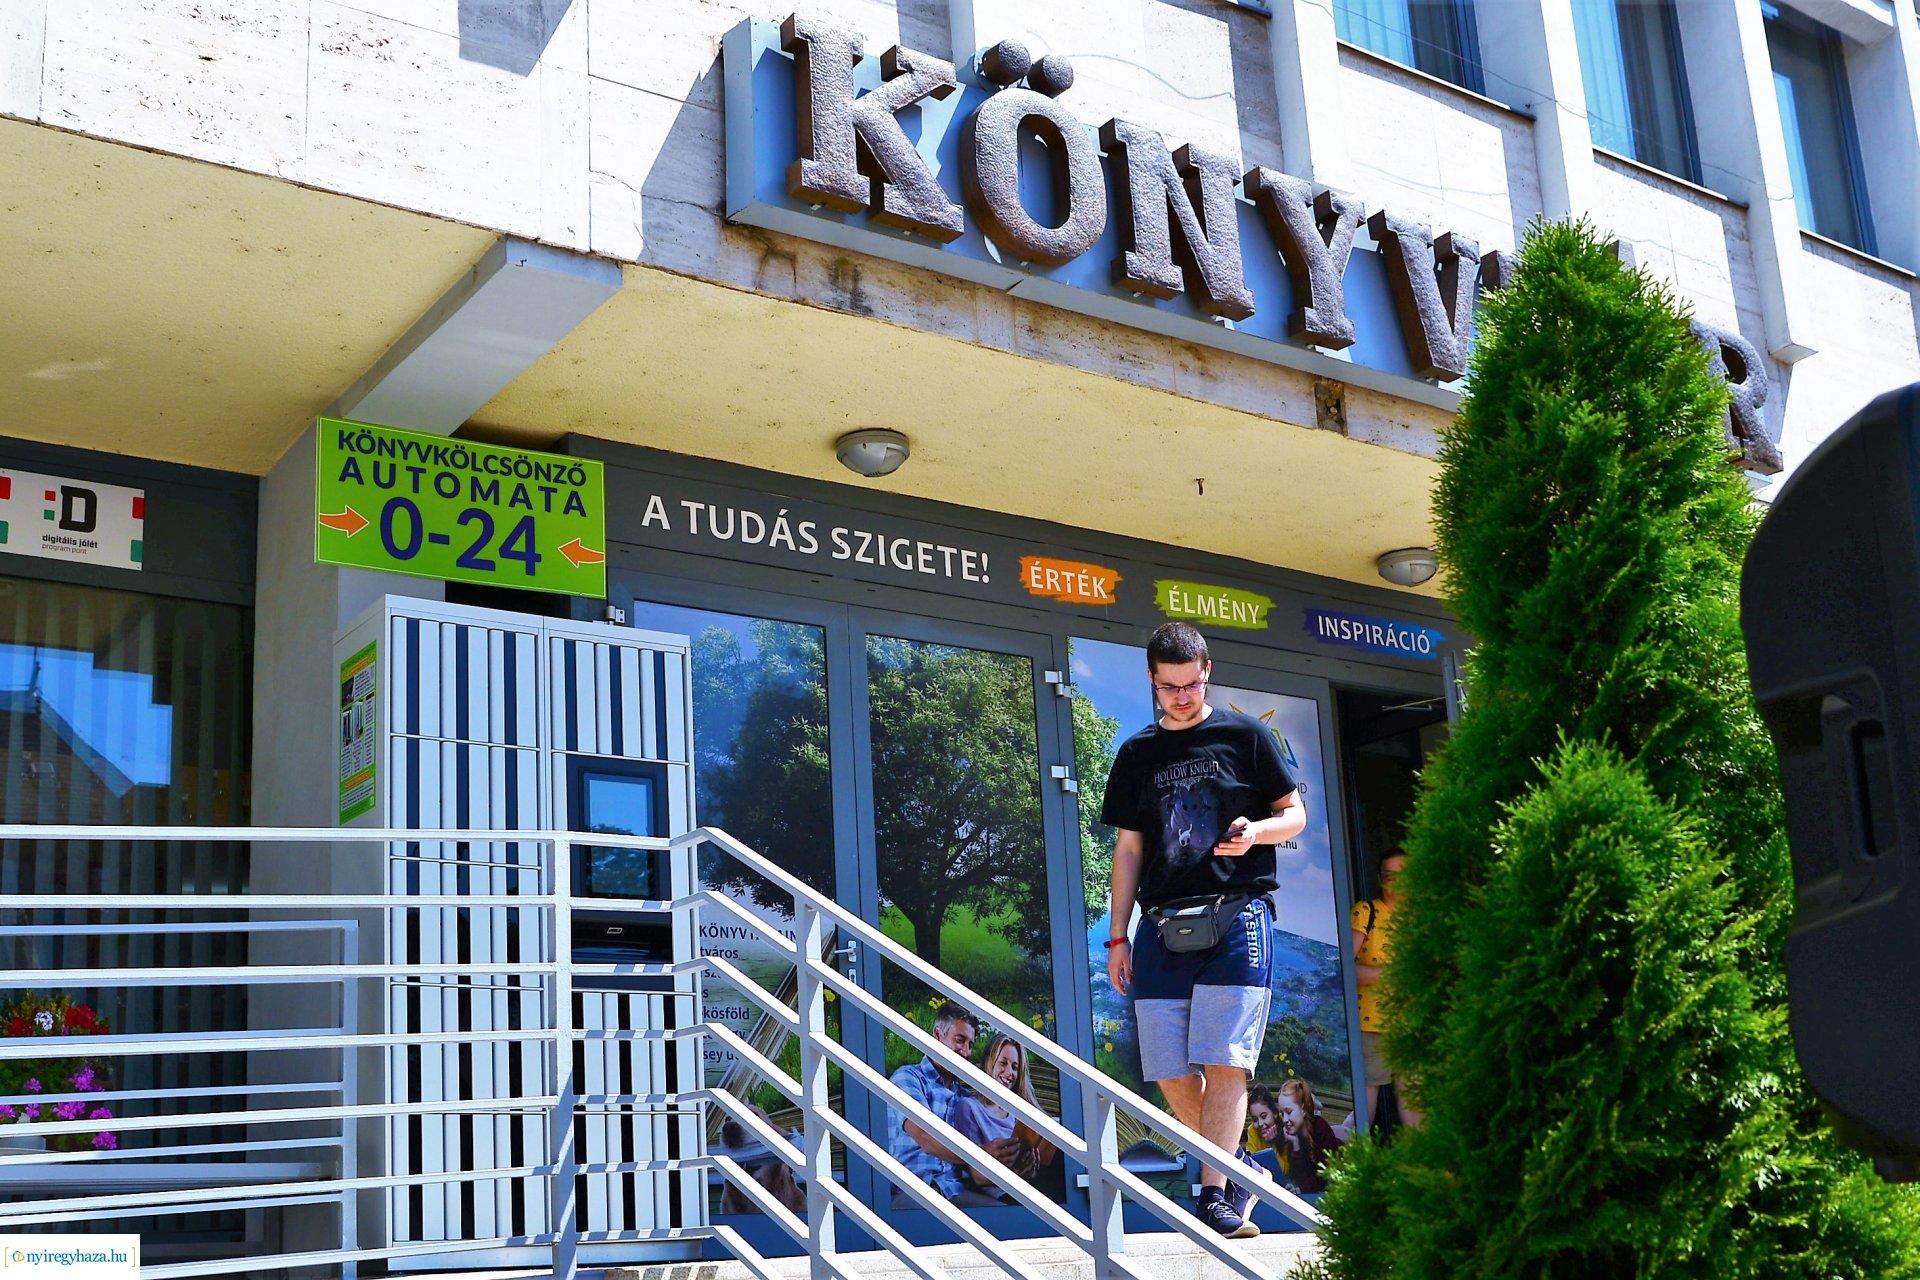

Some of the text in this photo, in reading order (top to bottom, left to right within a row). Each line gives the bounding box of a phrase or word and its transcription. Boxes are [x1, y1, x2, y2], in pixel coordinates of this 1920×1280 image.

[780, 12, 1784, 476] KÖNYVR
[338, 429, 587, 487] KÖNYVKÖLCSÖNZŐ
[338, 456, 587, 518] AUTOMATA
[41, 543, 71, 553] program
[42, 534, 99, 549] digitális jólét
[379, 496, 542, 577] 0-24
[641, 495, 991, 584] A TUDÁS SZIGETE!
[1029, 561, 1109, 600] ÉRTÉK
[1168, 585, 1261, 625] ÉLMÉNY
[1317, 615, 1432, 655] INSPIRÁCIÓ
[1154, 764, 1188, 785] HOLLOW
[1245, 903, 1260, 969] FASHION
[702, 1006, 750, 1020] kösföld
